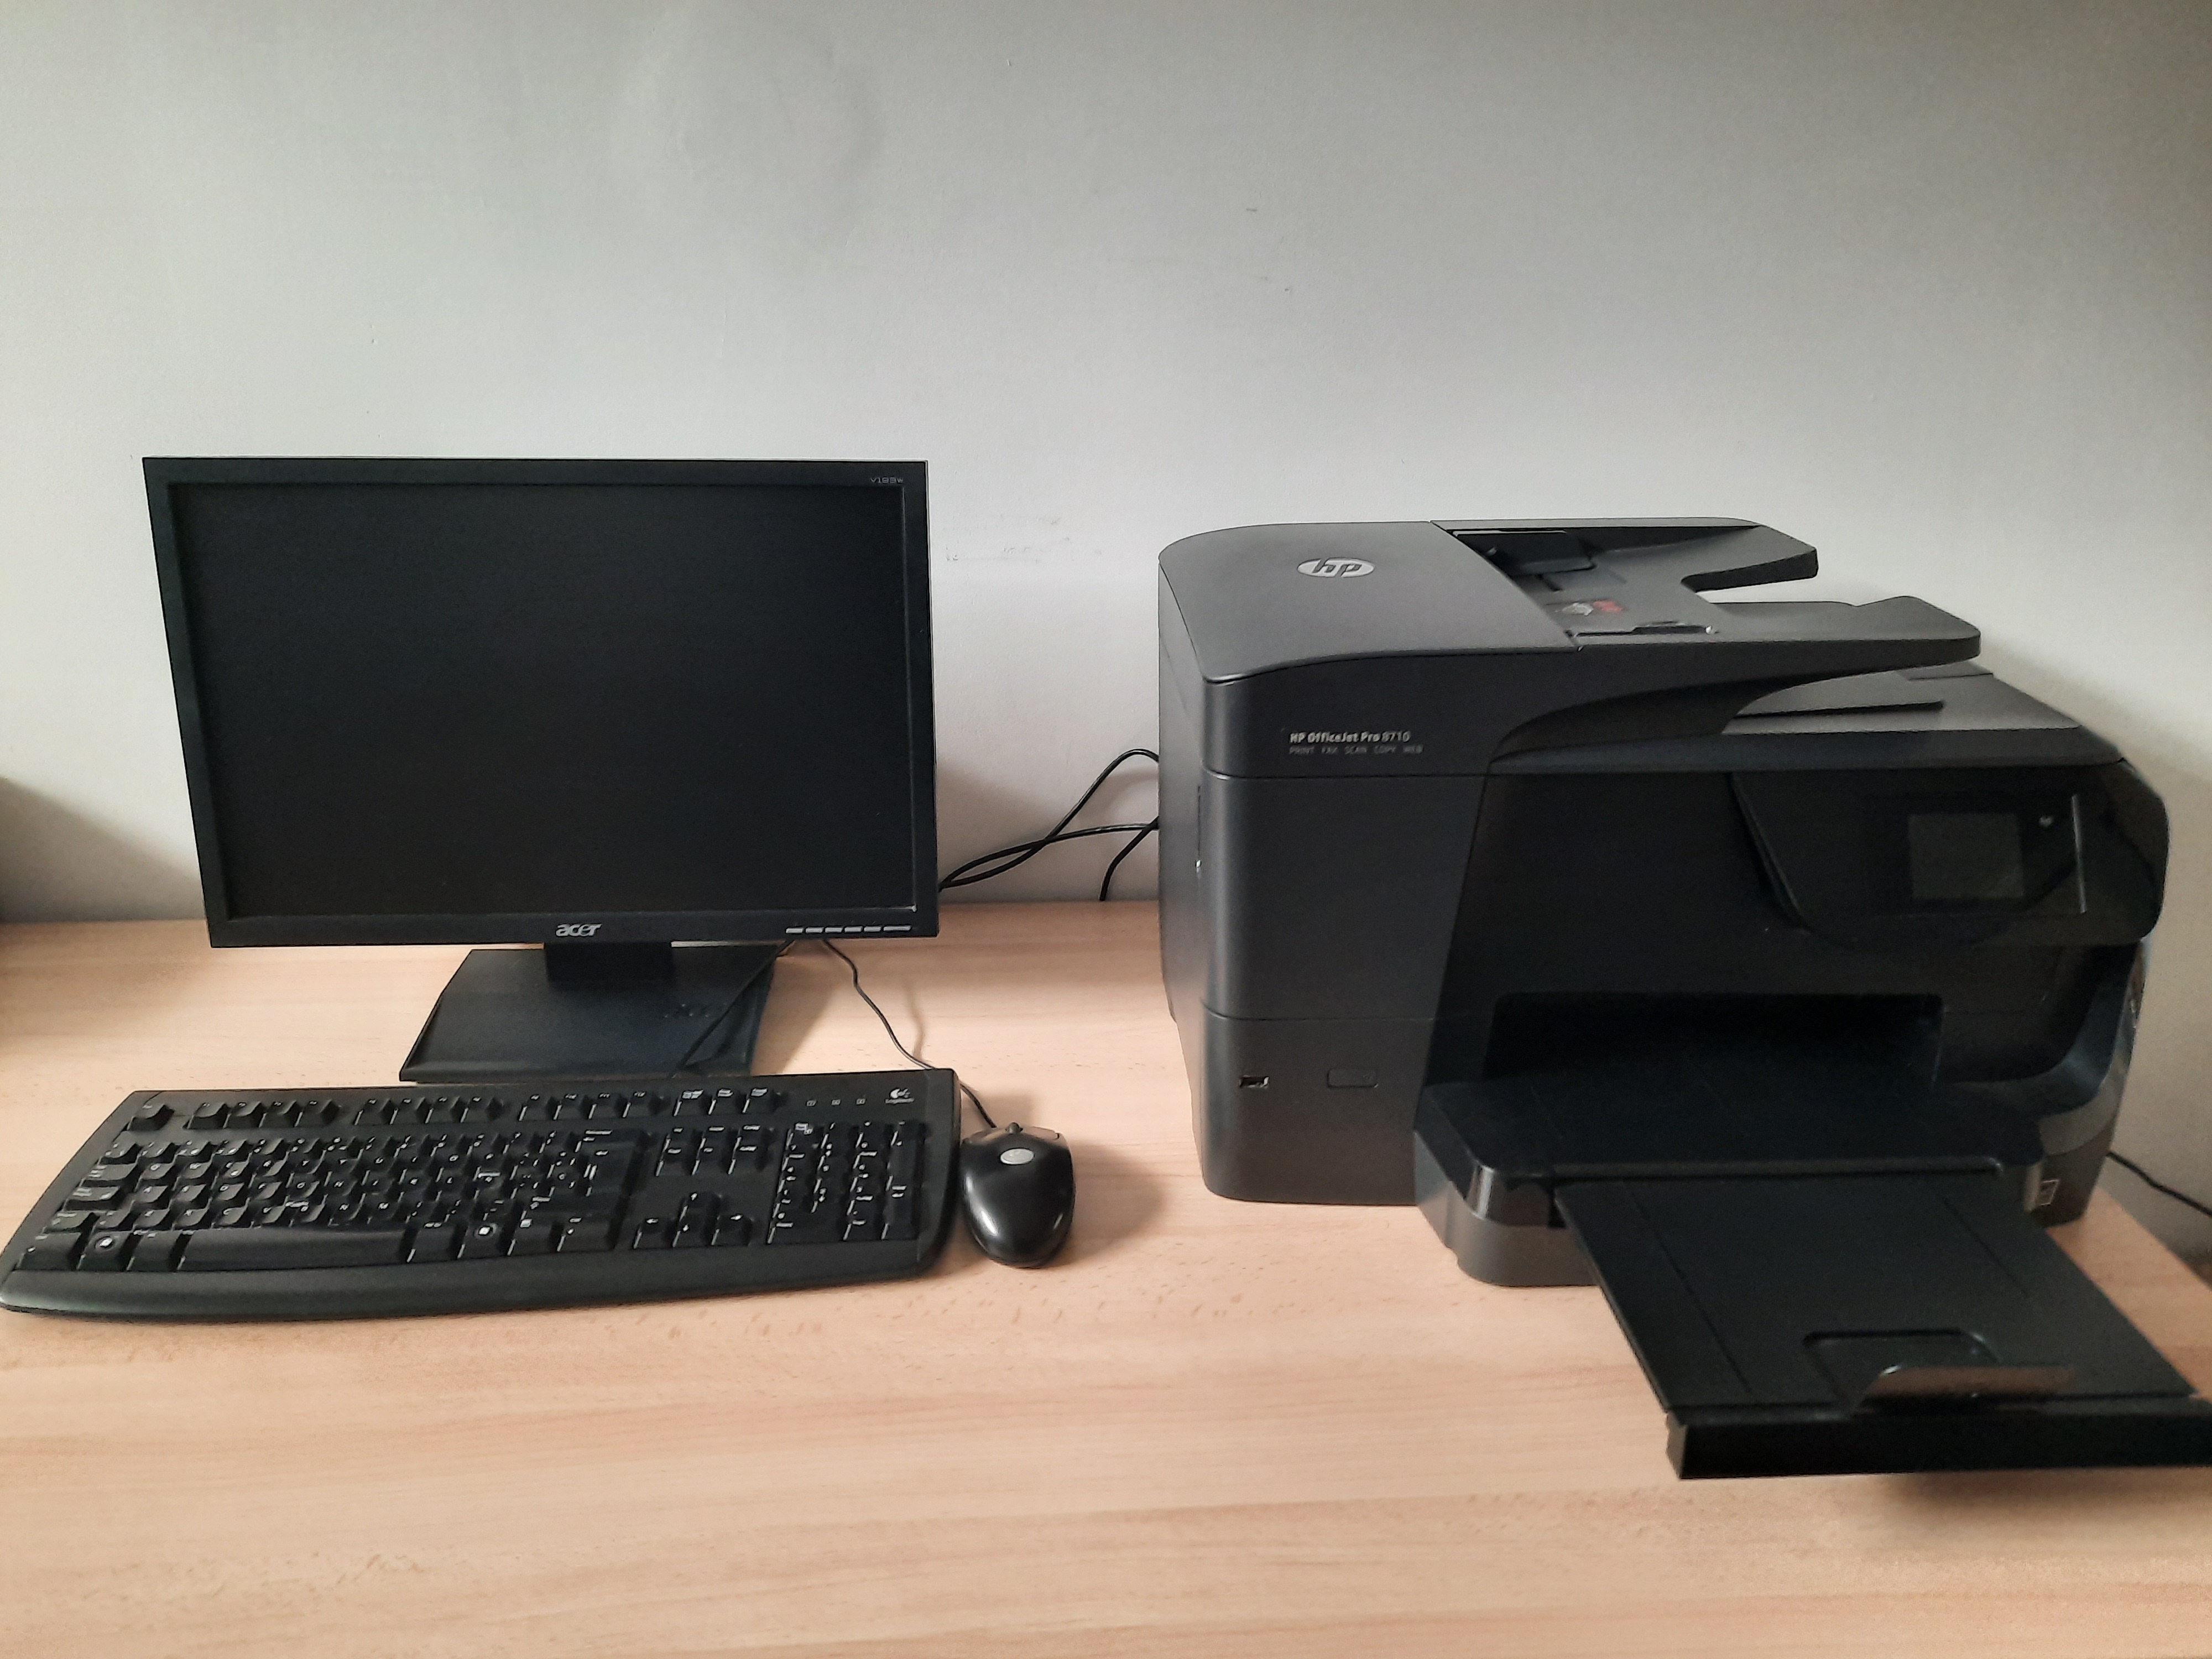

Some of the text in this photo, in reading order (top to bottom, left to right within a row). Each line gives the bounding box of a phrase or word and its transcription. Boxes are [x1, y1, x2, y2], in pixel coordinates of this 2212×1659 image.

[1312, 558, 1362, 578] hp
[1290, 732, 1306, 743] HP
[1360, 731, 1380, 742] Pro
[556, 924, 602, 936] acer
